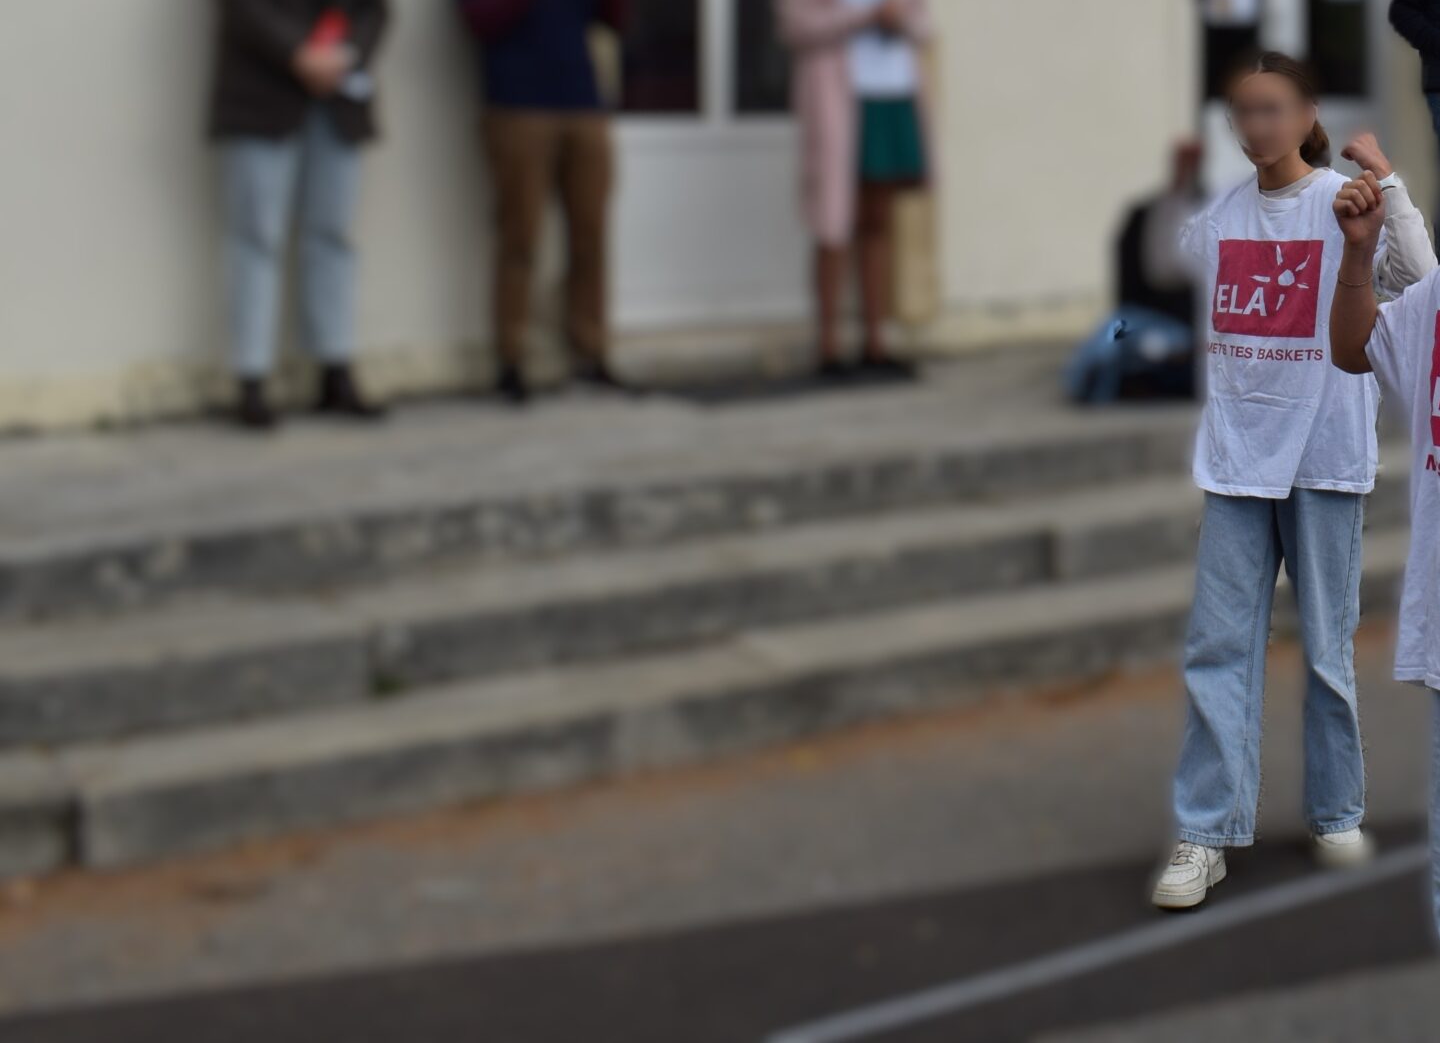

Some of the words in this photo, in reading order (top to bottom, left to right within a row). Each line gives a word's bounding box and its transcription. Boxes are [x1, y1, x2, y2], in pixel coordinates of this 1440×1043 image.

[1216, 284, 1267, 317] ELA
[1230, 345, 1253, 358] TES
[1256, 349, 1324, 361] BASKETS
